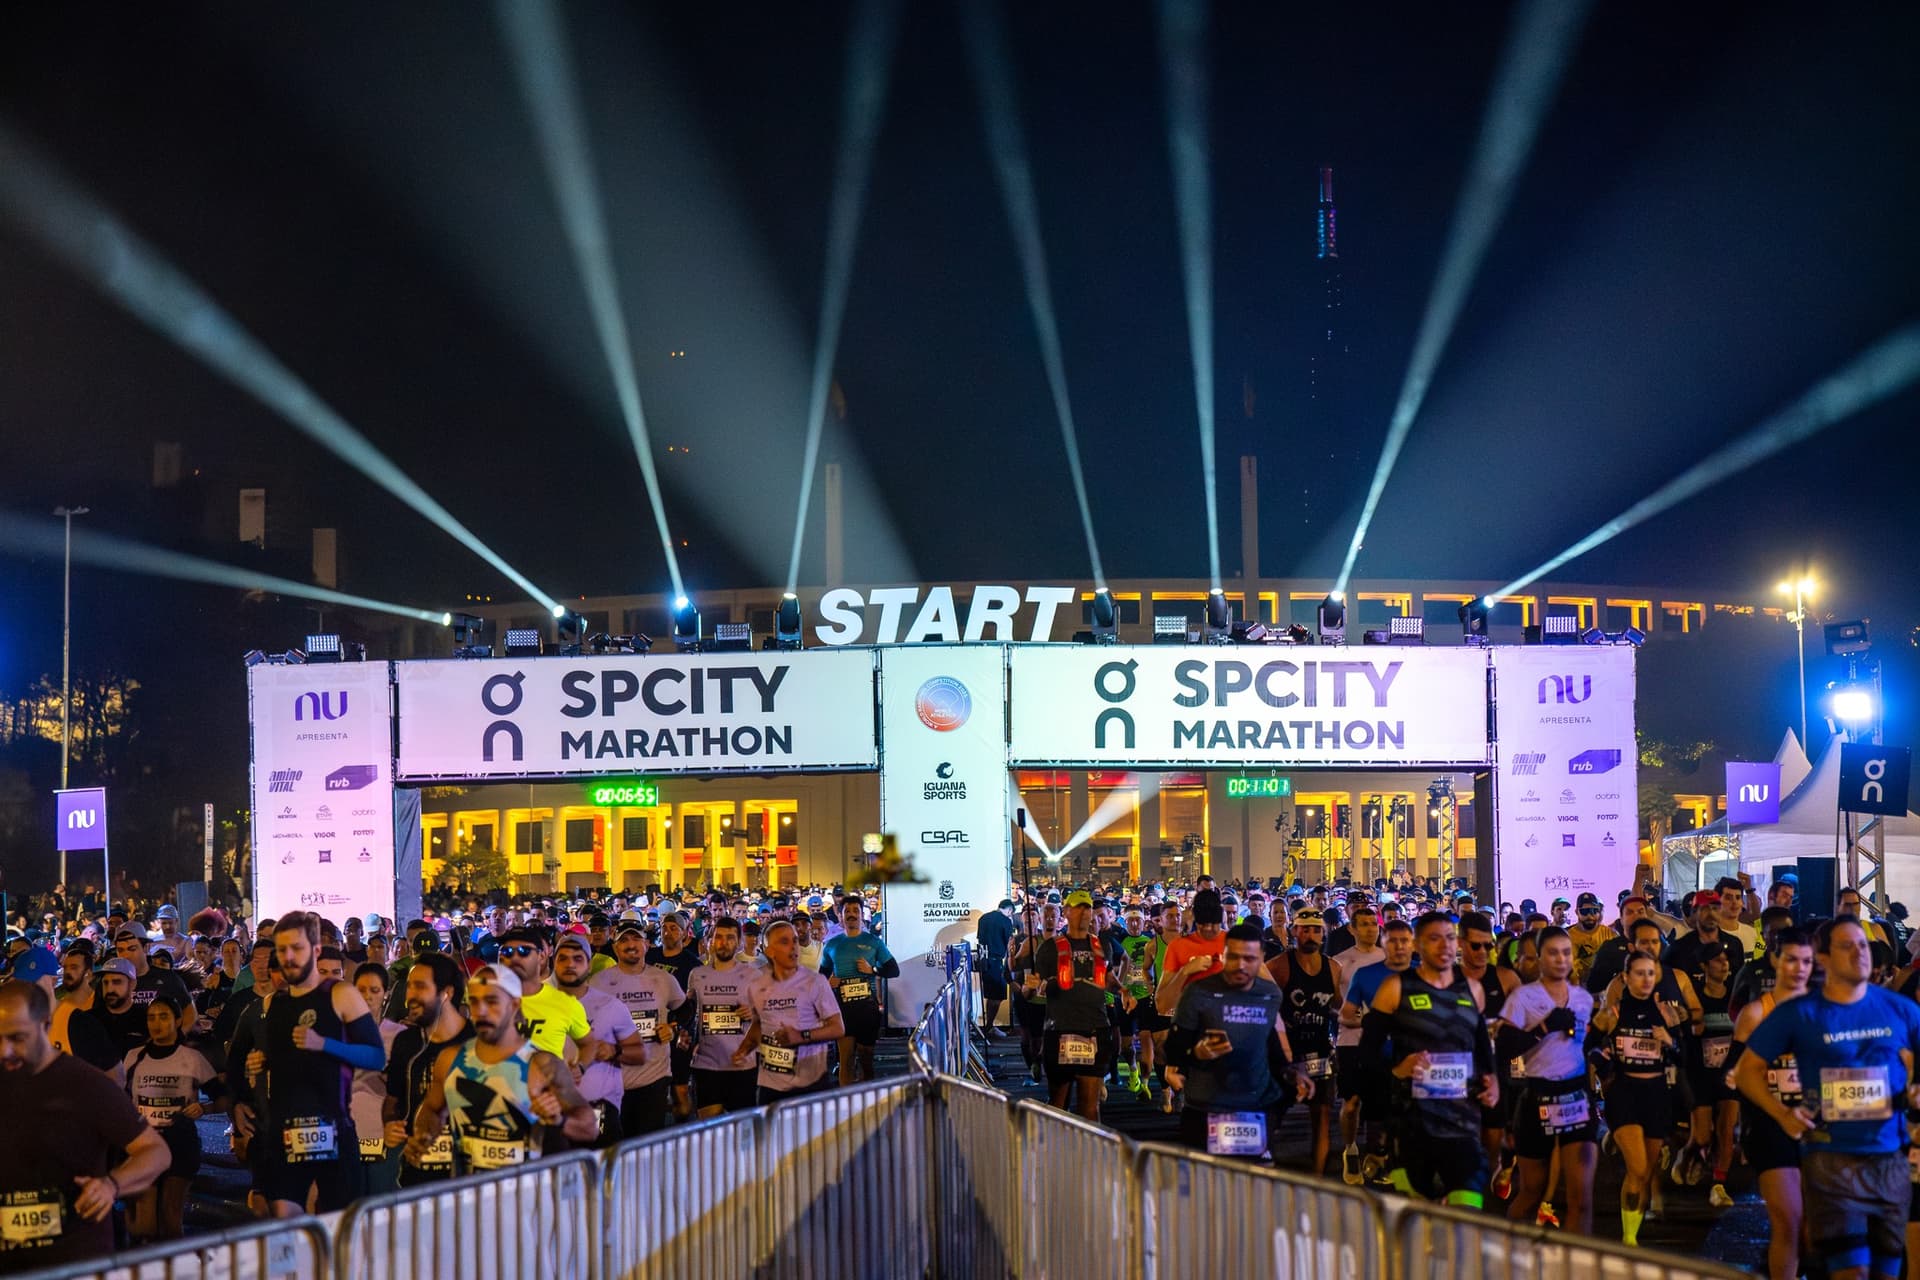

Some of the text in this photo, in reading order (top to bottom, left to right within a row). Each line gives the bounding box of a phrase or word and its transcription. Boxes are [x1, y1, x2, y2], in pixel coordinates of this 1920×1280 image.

[815, 585, 1076, 645] START
[1172, 659, 1404, 708] SPCITY
[560, 665, 790, 718] SPCITY
[1540, 716, 1592, 724] APRESENTA
[296, 732, 348, 741] APRESENTA
[1173, 720, 1405, 750] MARATHON
[561, 725, 793, 760] MARATHON
[1512, 750, 1546, 764] amino
[269, 768, 303, 781] amino
[1512, 764, 1539, 775] VITAL
[269, 781, 294, 792] VITAL
[924, 782, 967, 790] IGUANA
[924, 791, 967, 800] SPORTS
[923, 908, 971, 917] SÃO PAULO
[622, 991, 654, 999] SPCITY
[768, 998, 797, 1007] SPCITY
[635, 1022, 651, 1031] 914
[143, 1075, 180, 1084] SPCITY
[1224, 1126, 1257, 1137] 21559
[297, 1131, 328, 1144] 5108
[481, 1145, 516, 1160] 1654
